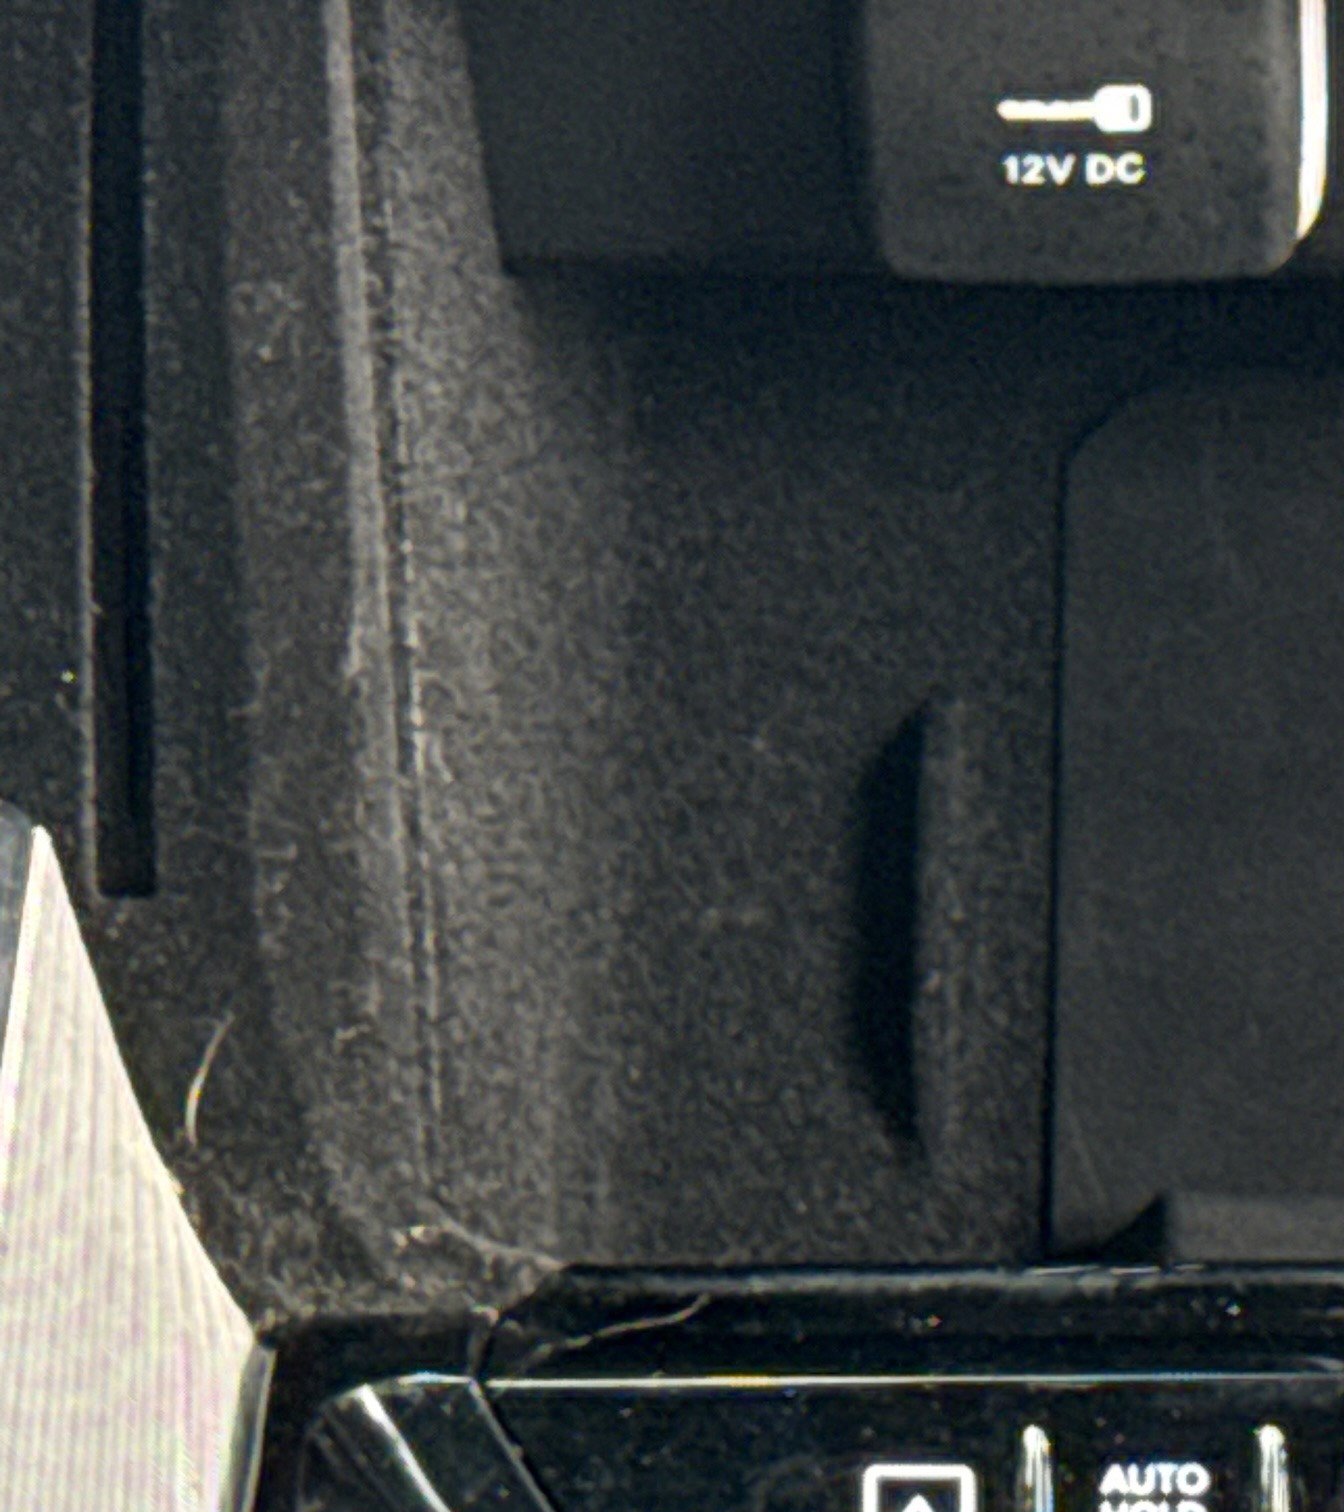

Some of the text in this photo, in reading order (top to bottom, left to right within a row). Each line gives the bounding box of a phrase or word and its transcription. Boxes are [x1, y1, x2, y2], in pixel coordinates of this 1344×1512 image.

[1003, 154, 1146, 186] 12V DC
[1100, 1462, 1210, 1496] AUTO
